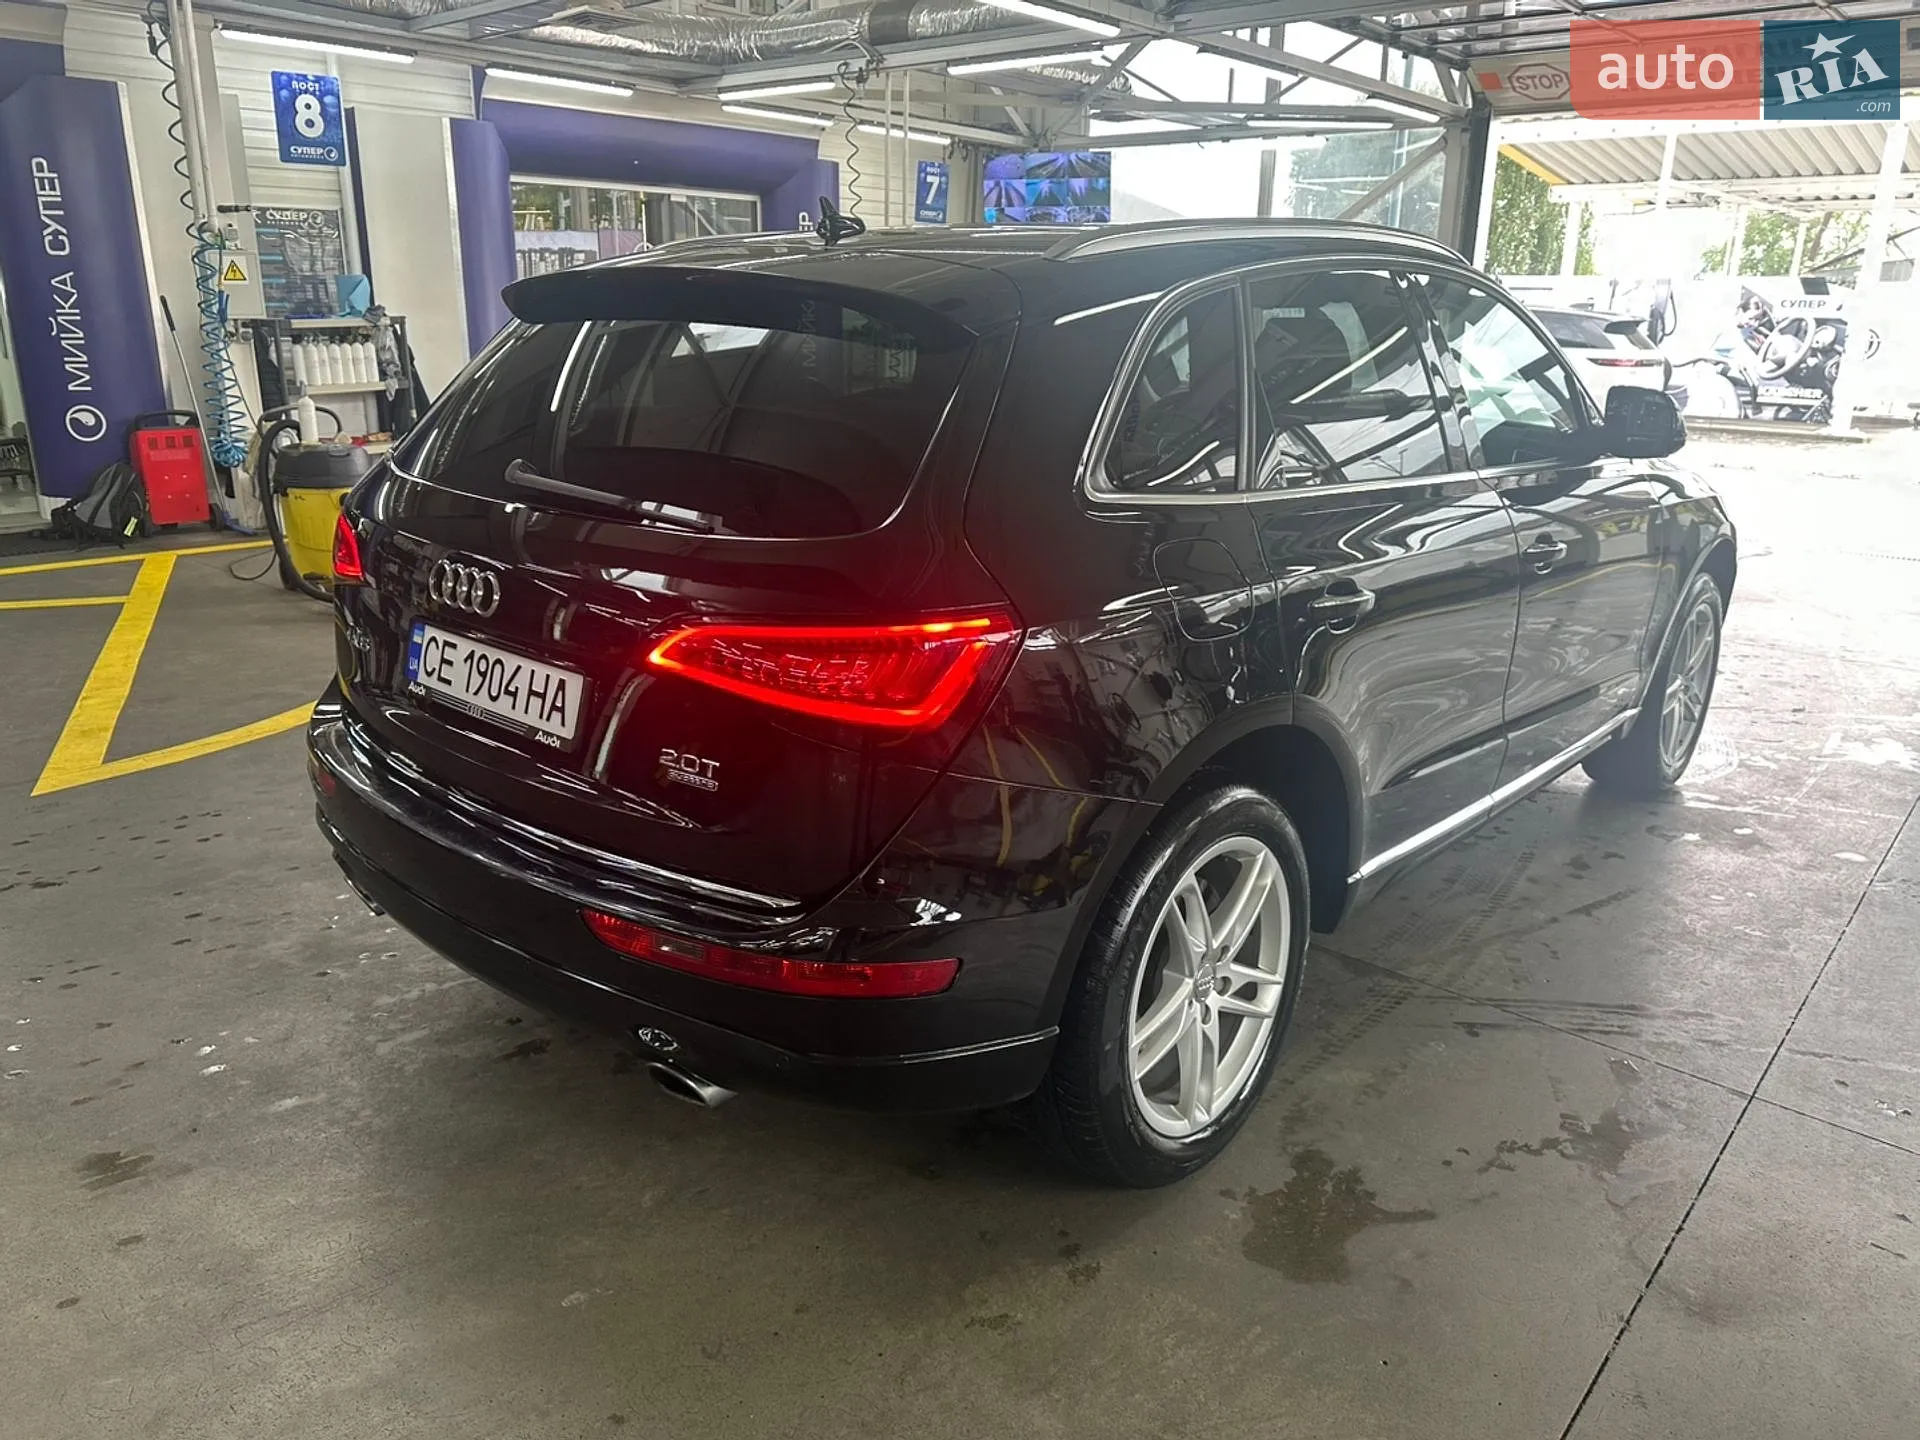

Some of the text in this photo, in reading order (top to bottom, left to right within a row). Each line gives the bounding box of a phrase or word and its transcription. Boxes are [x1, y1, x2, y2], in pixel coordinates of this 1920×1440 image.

[1516, 73, 1565, 93] STOP
[294, 93, 325, 138] 8
[925, 174, 940, 205] 7
[31, 157, 93, 391] МИЙКА СУПЕР
[1780, 299, 1827, 309] СУПЕР
[407, 681, 426, 697] Audi
[423, 635, 567, 728] CE 1904 HA
[534, 730, 561, 749] Audi
